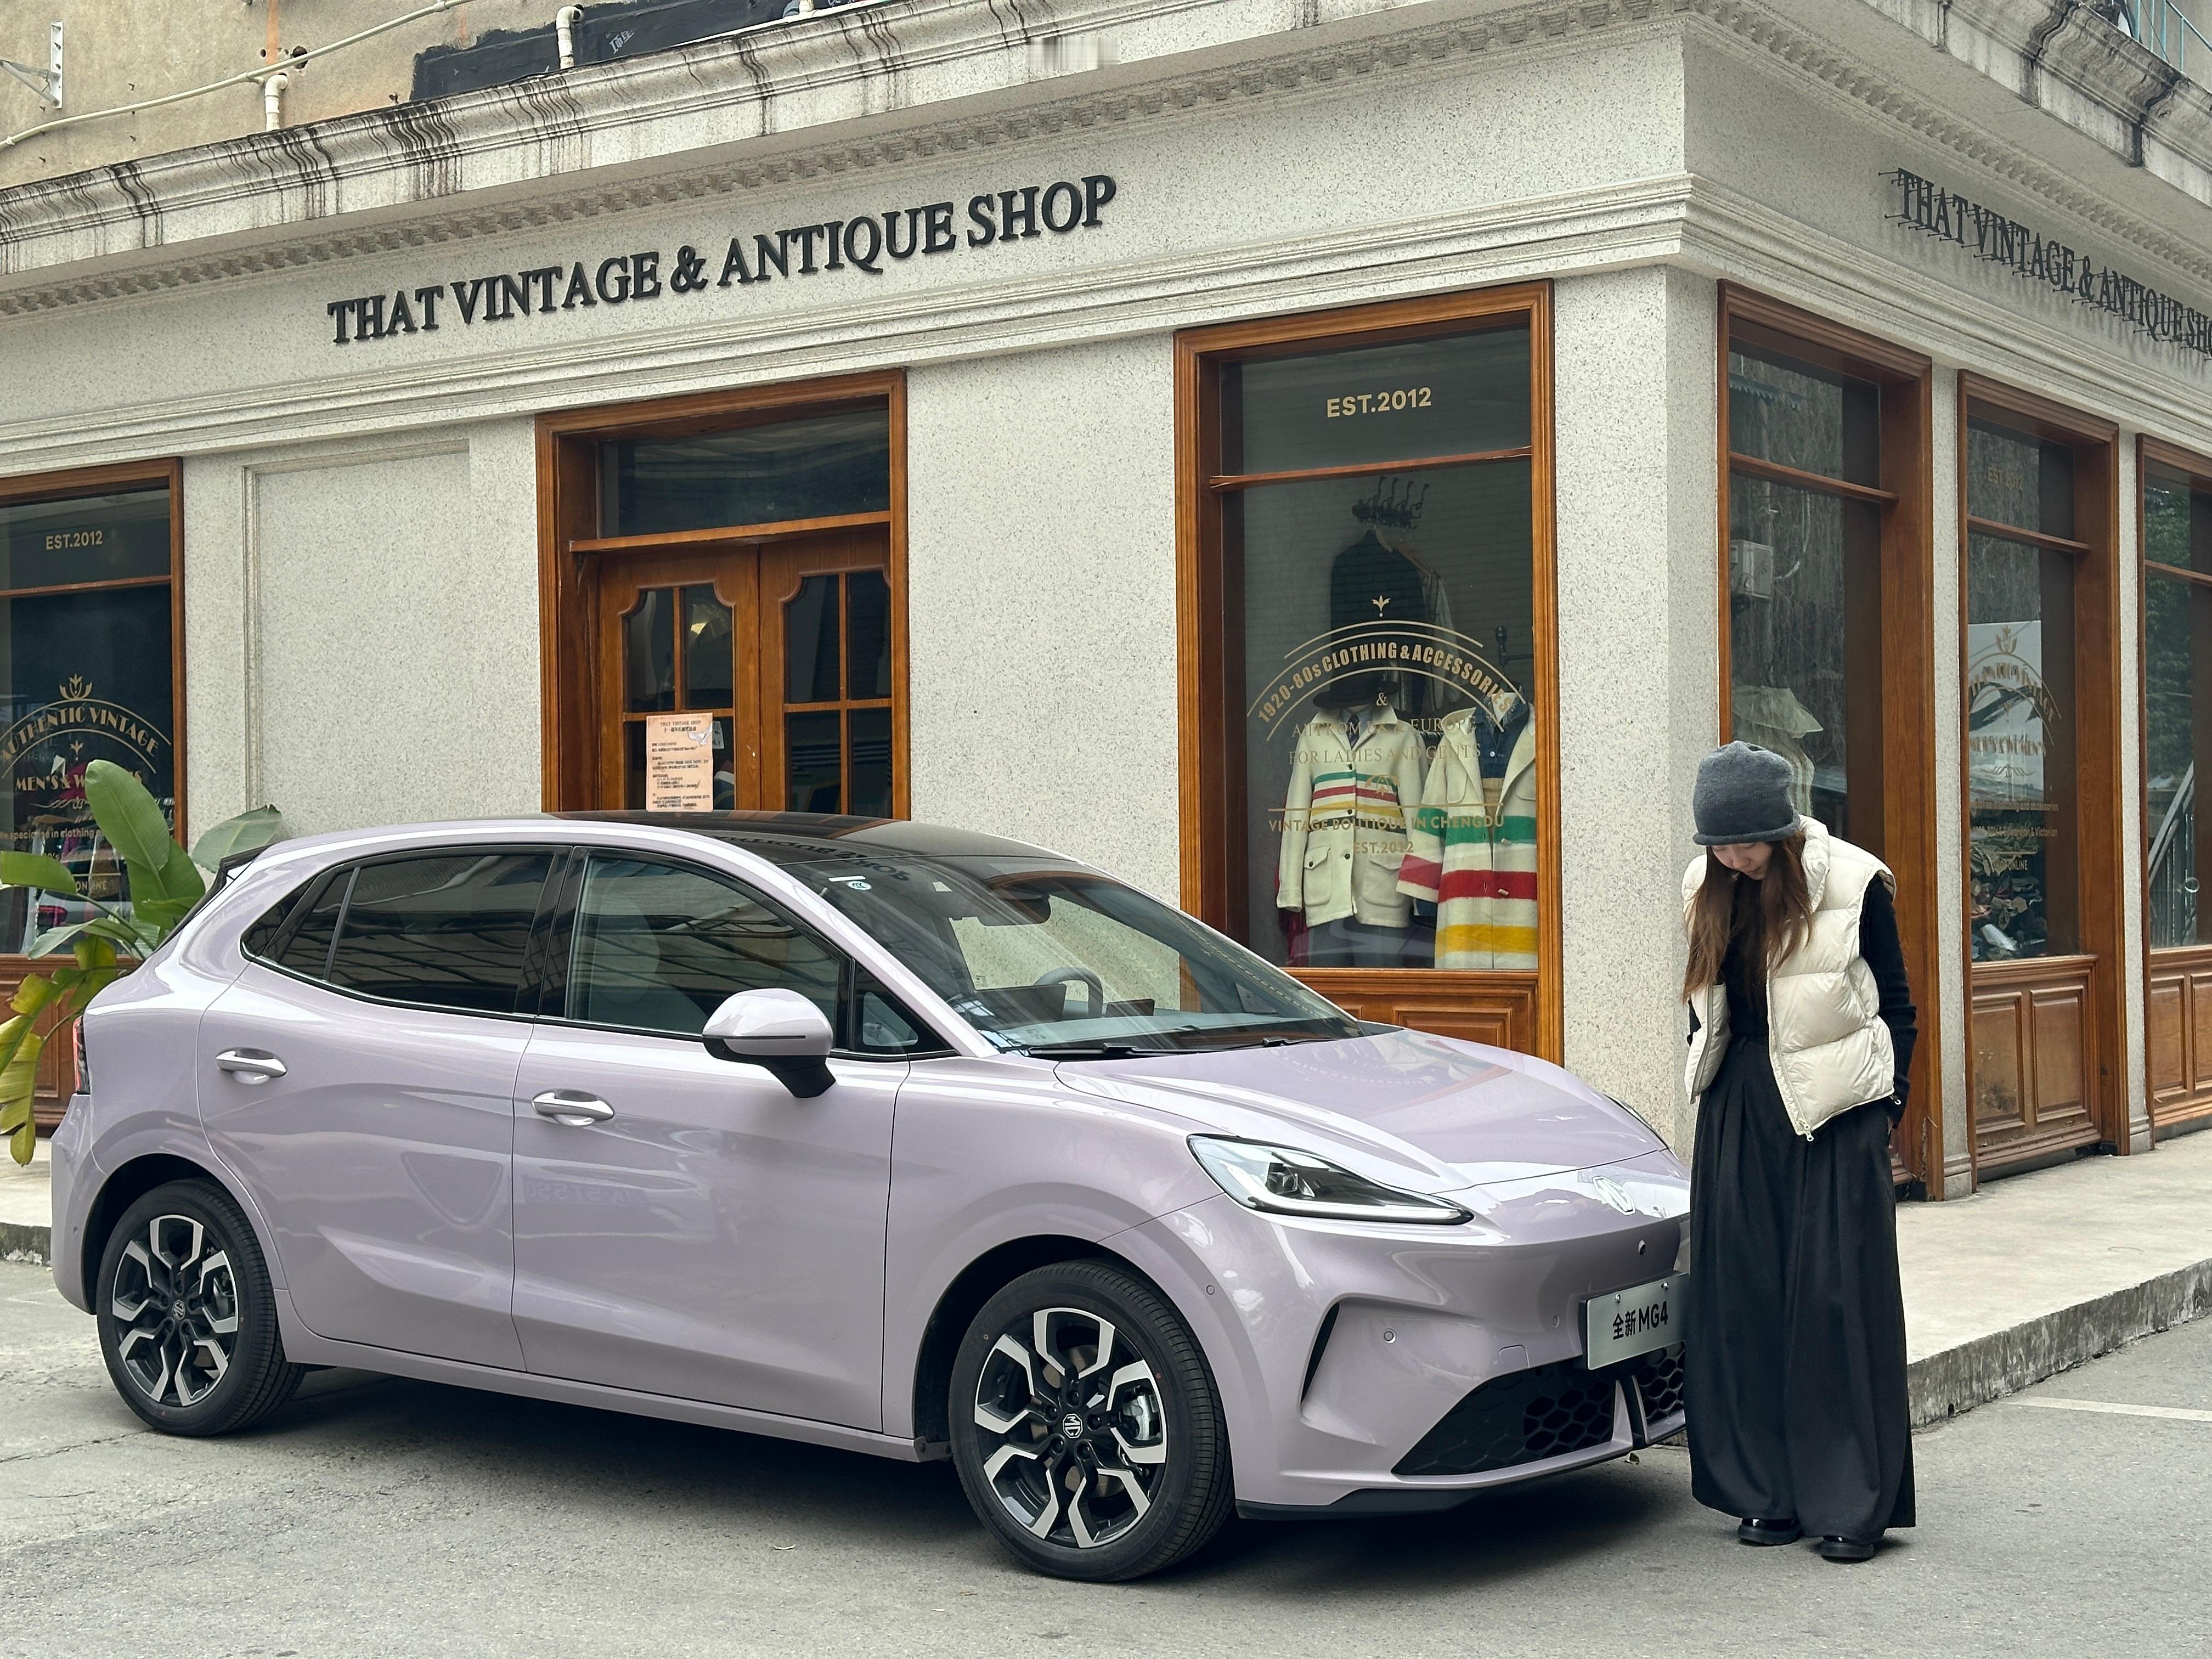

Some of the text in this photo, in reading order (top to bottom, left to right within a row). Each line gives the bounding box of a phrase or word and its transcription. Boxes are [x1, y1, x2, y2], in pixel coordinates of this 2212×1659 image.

[328, 174, 1116, 343] THAT VINTAGE & ANTIQUE SHOP
[1898, 167, 1968, 244] THAT
[1972, 202, 2075, 294] VINTAGE
[2078, 255, 2096, 302] &
[2099, 266, 2183, 342] ANTIQUE
[1327, 386, 1432, 418] EST.2012
[46, 530, 103, 550] EST.2012
[1258, 663, 1322, 723] 1920-80s
[1322, 642, 1397, 673] CLOTHING
[1412, 644, 1513, 713] ACCESSORIES
[1376, 692, 1388, 706] &
[89, 706, 159, 757] VINTAGE
[1289, 742, 1481, 764] FOR LADIES AND GENTS
[15, 775, 59, 791] MEN'S
[60, 827, 94, 838] clothing
[1268, 814, 1505, 832] VINTAGE BOUTIQUE IN CHENGDU
[1353, 840, 1414, 854] EST.2012
[1612, 1300, 1668, 1340] 全新 MG4
